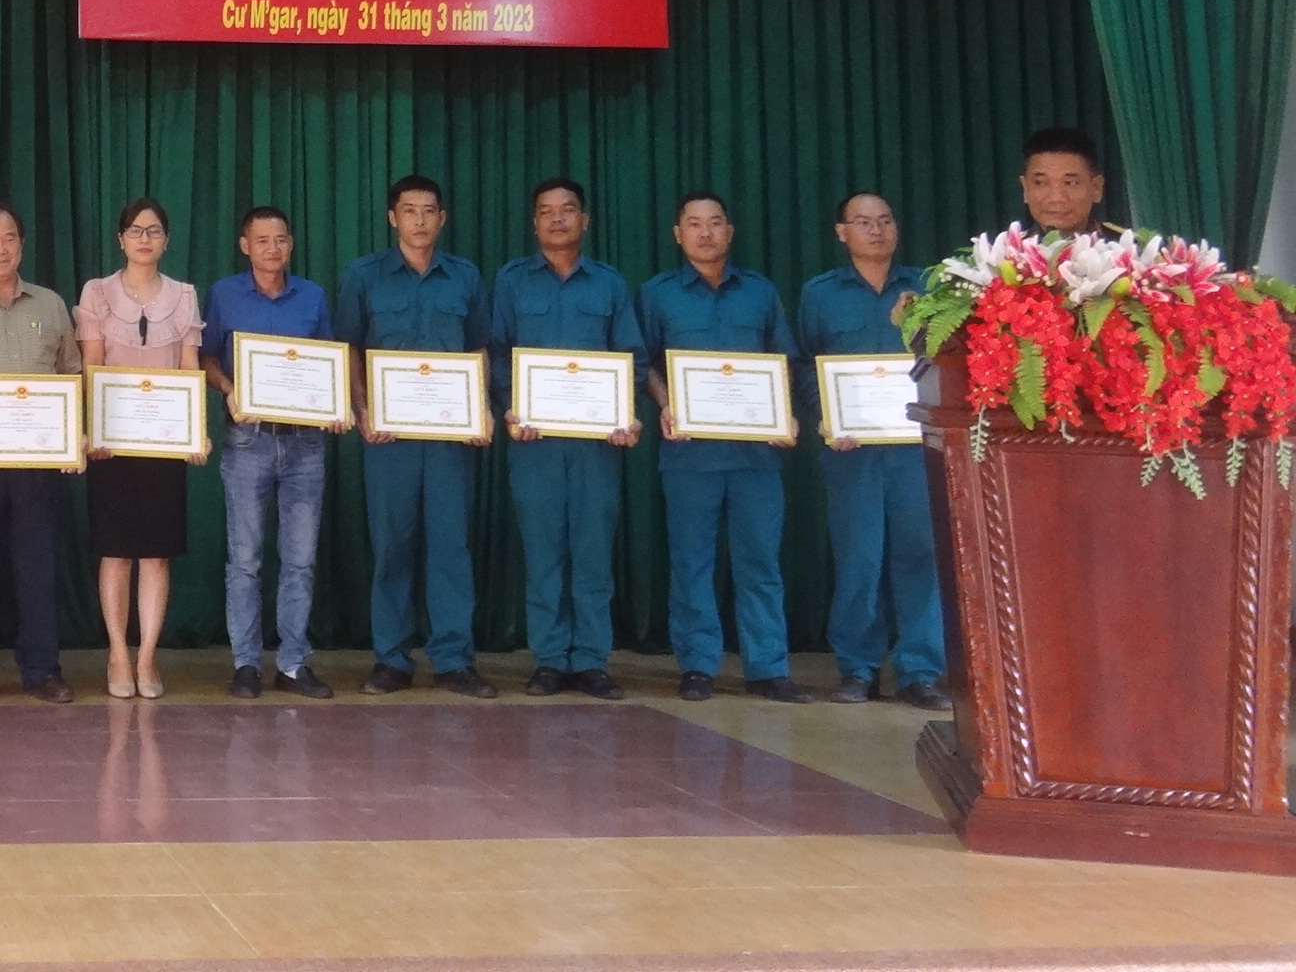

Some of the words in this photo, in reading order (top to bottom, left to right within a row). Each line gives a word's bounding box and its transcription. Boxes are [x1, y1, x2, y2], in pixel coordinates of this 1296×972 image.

[307, 0, 348, 36] ngày
[358, 1, 377, 31] 31
[384, 1, 432, 37] tháng
[437, 3, 447, 32] 3
[452, 3, 488, 32] năm
[494, 4, 533, 32] 2023
